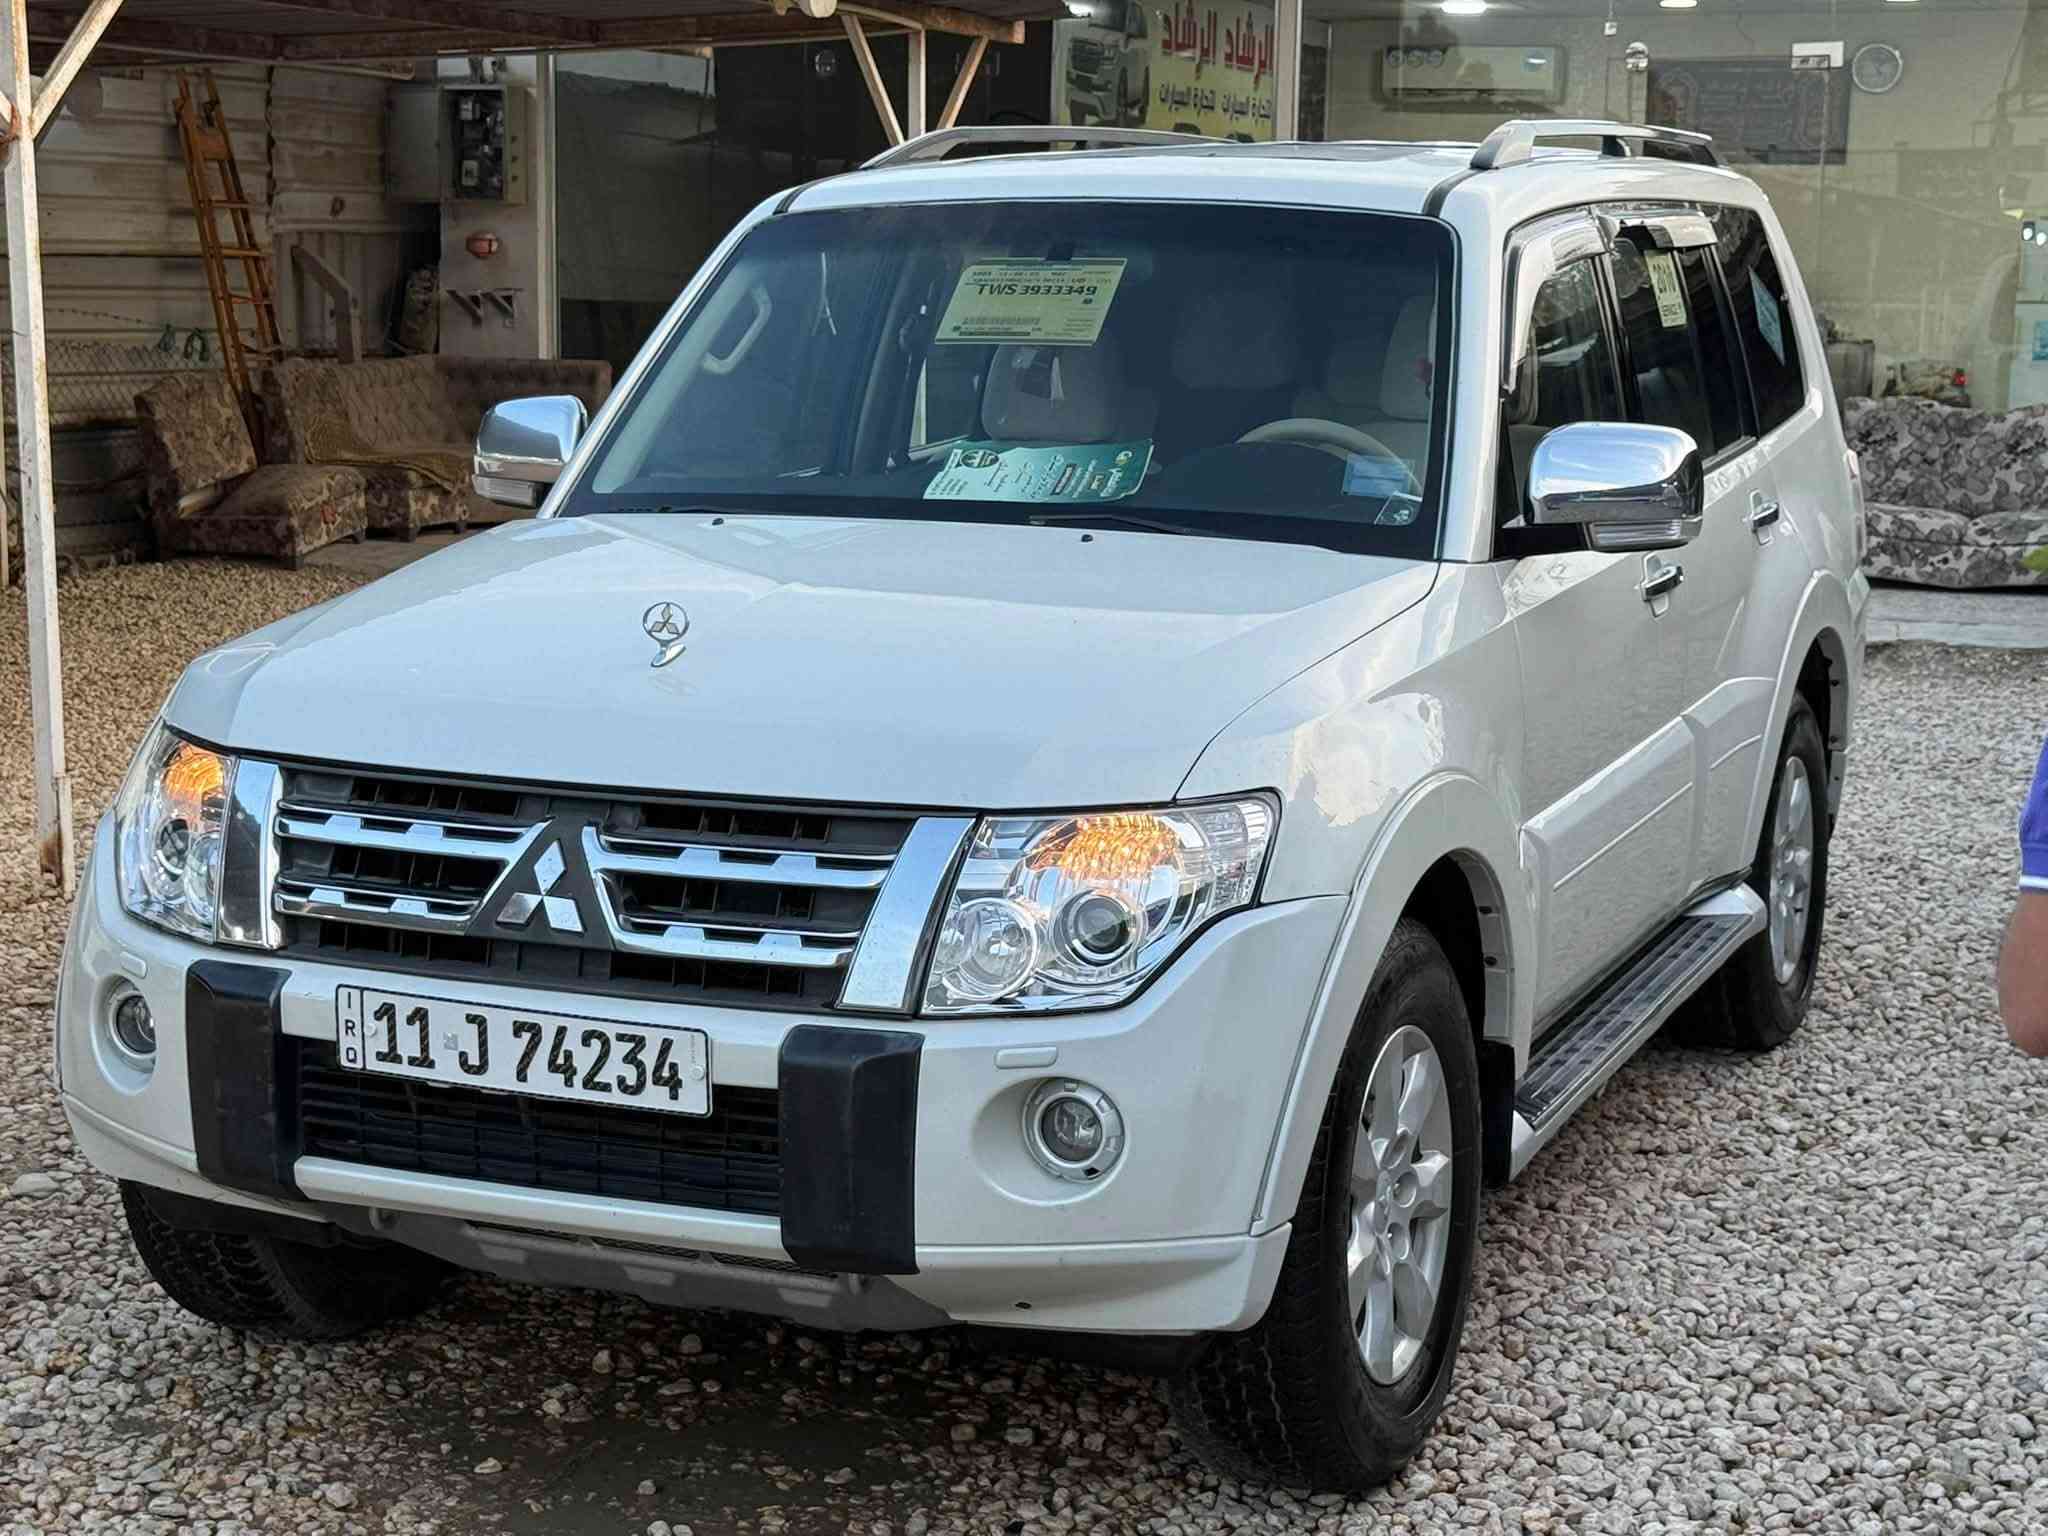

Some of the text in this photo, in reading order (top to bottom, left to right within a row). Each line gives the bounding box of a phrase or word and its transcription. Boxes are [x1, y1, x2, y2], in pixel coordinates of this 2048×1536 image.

[344, 991, 358, 1065] IRQ
[373, 1001, 436, 1069] 11
[458, 1012, 489, 1076] J
[512, 1019, 684, 1101] 74234
